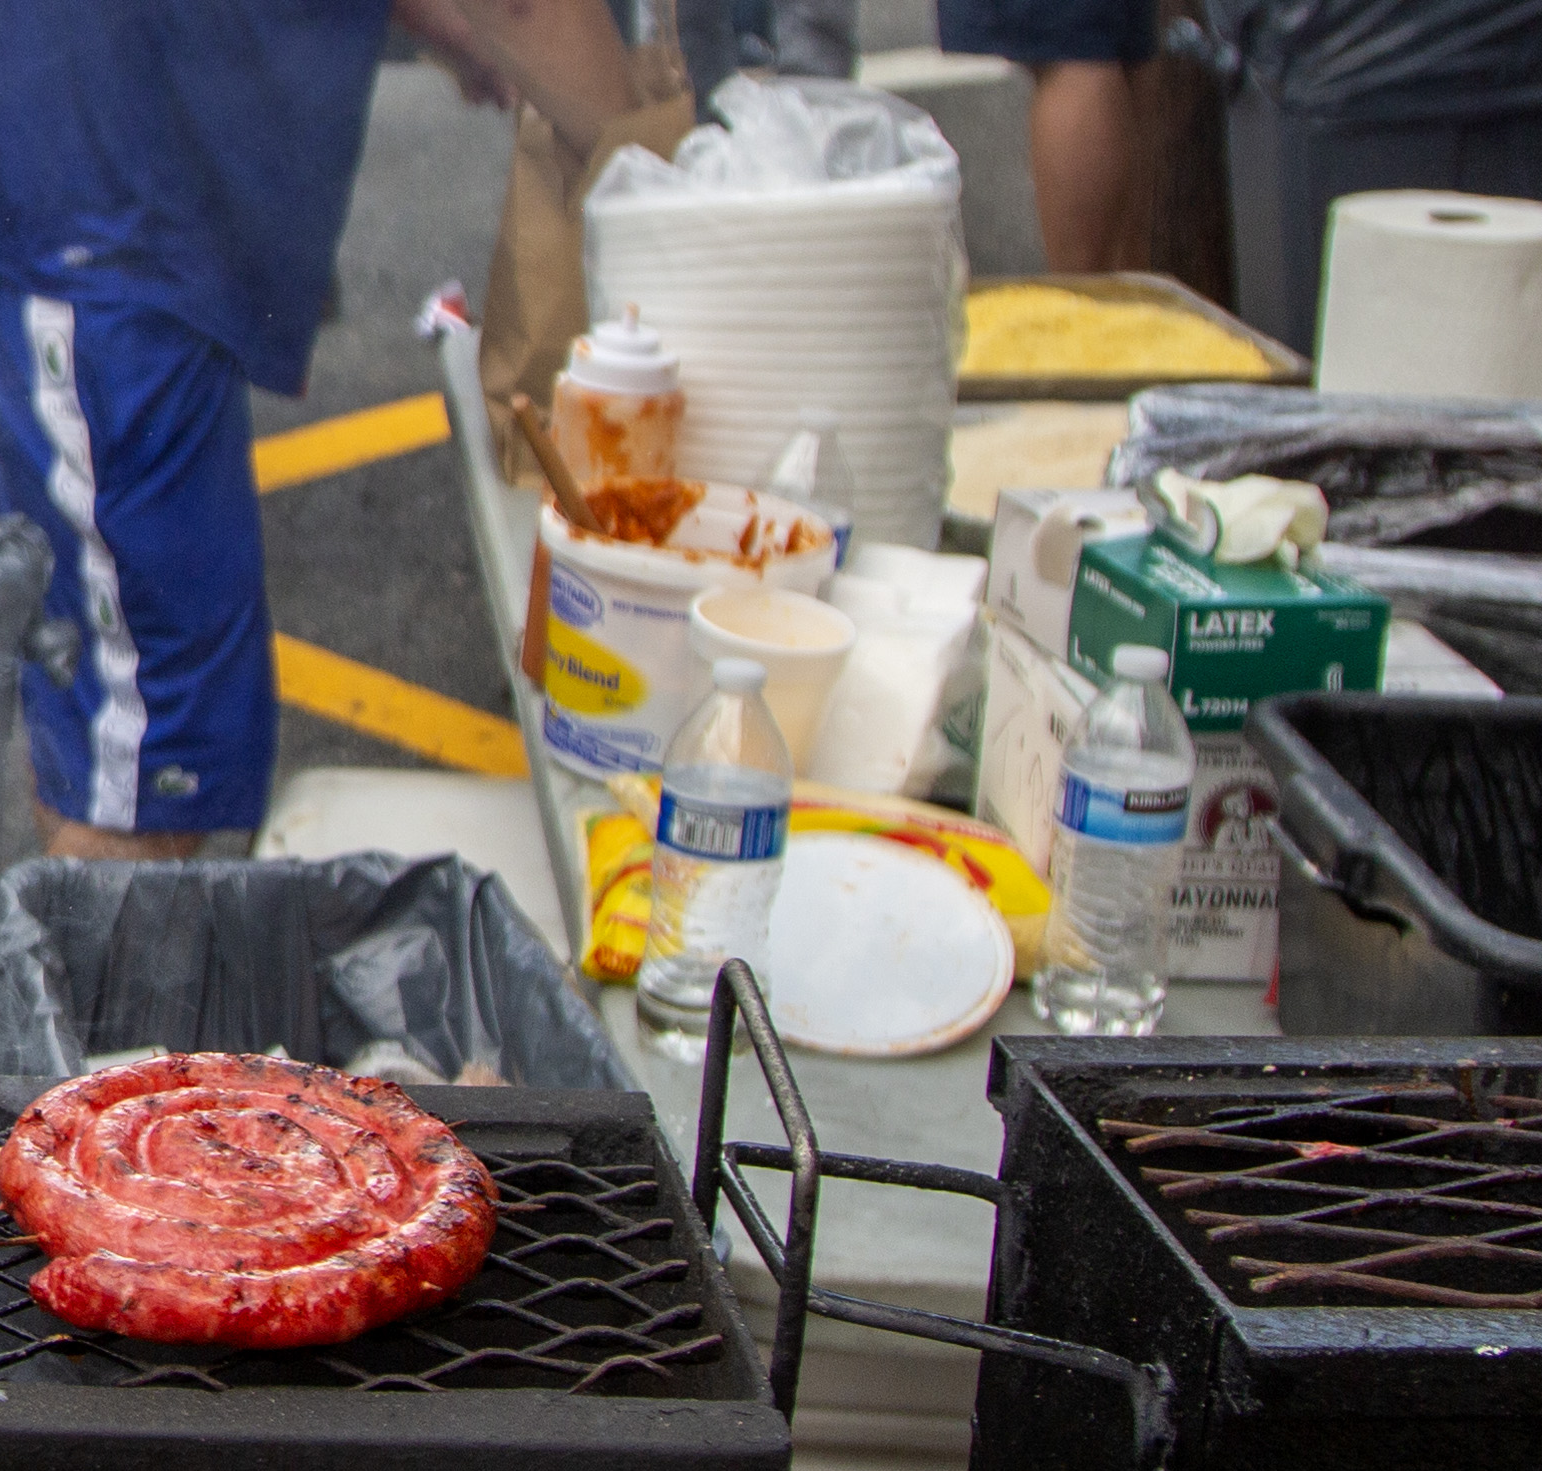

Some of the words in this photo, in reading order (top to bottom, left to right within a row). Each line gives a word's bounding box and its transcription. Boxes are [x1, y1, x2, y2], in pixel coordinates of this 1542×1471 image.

[633, 603, 691, 622] REFRIGERATE
[1187, 609, 1276, 639] LATEX
[1126, 788, 1187, 809] KIRKLAN
[1170, 885, 1280, 909] AYONNA
